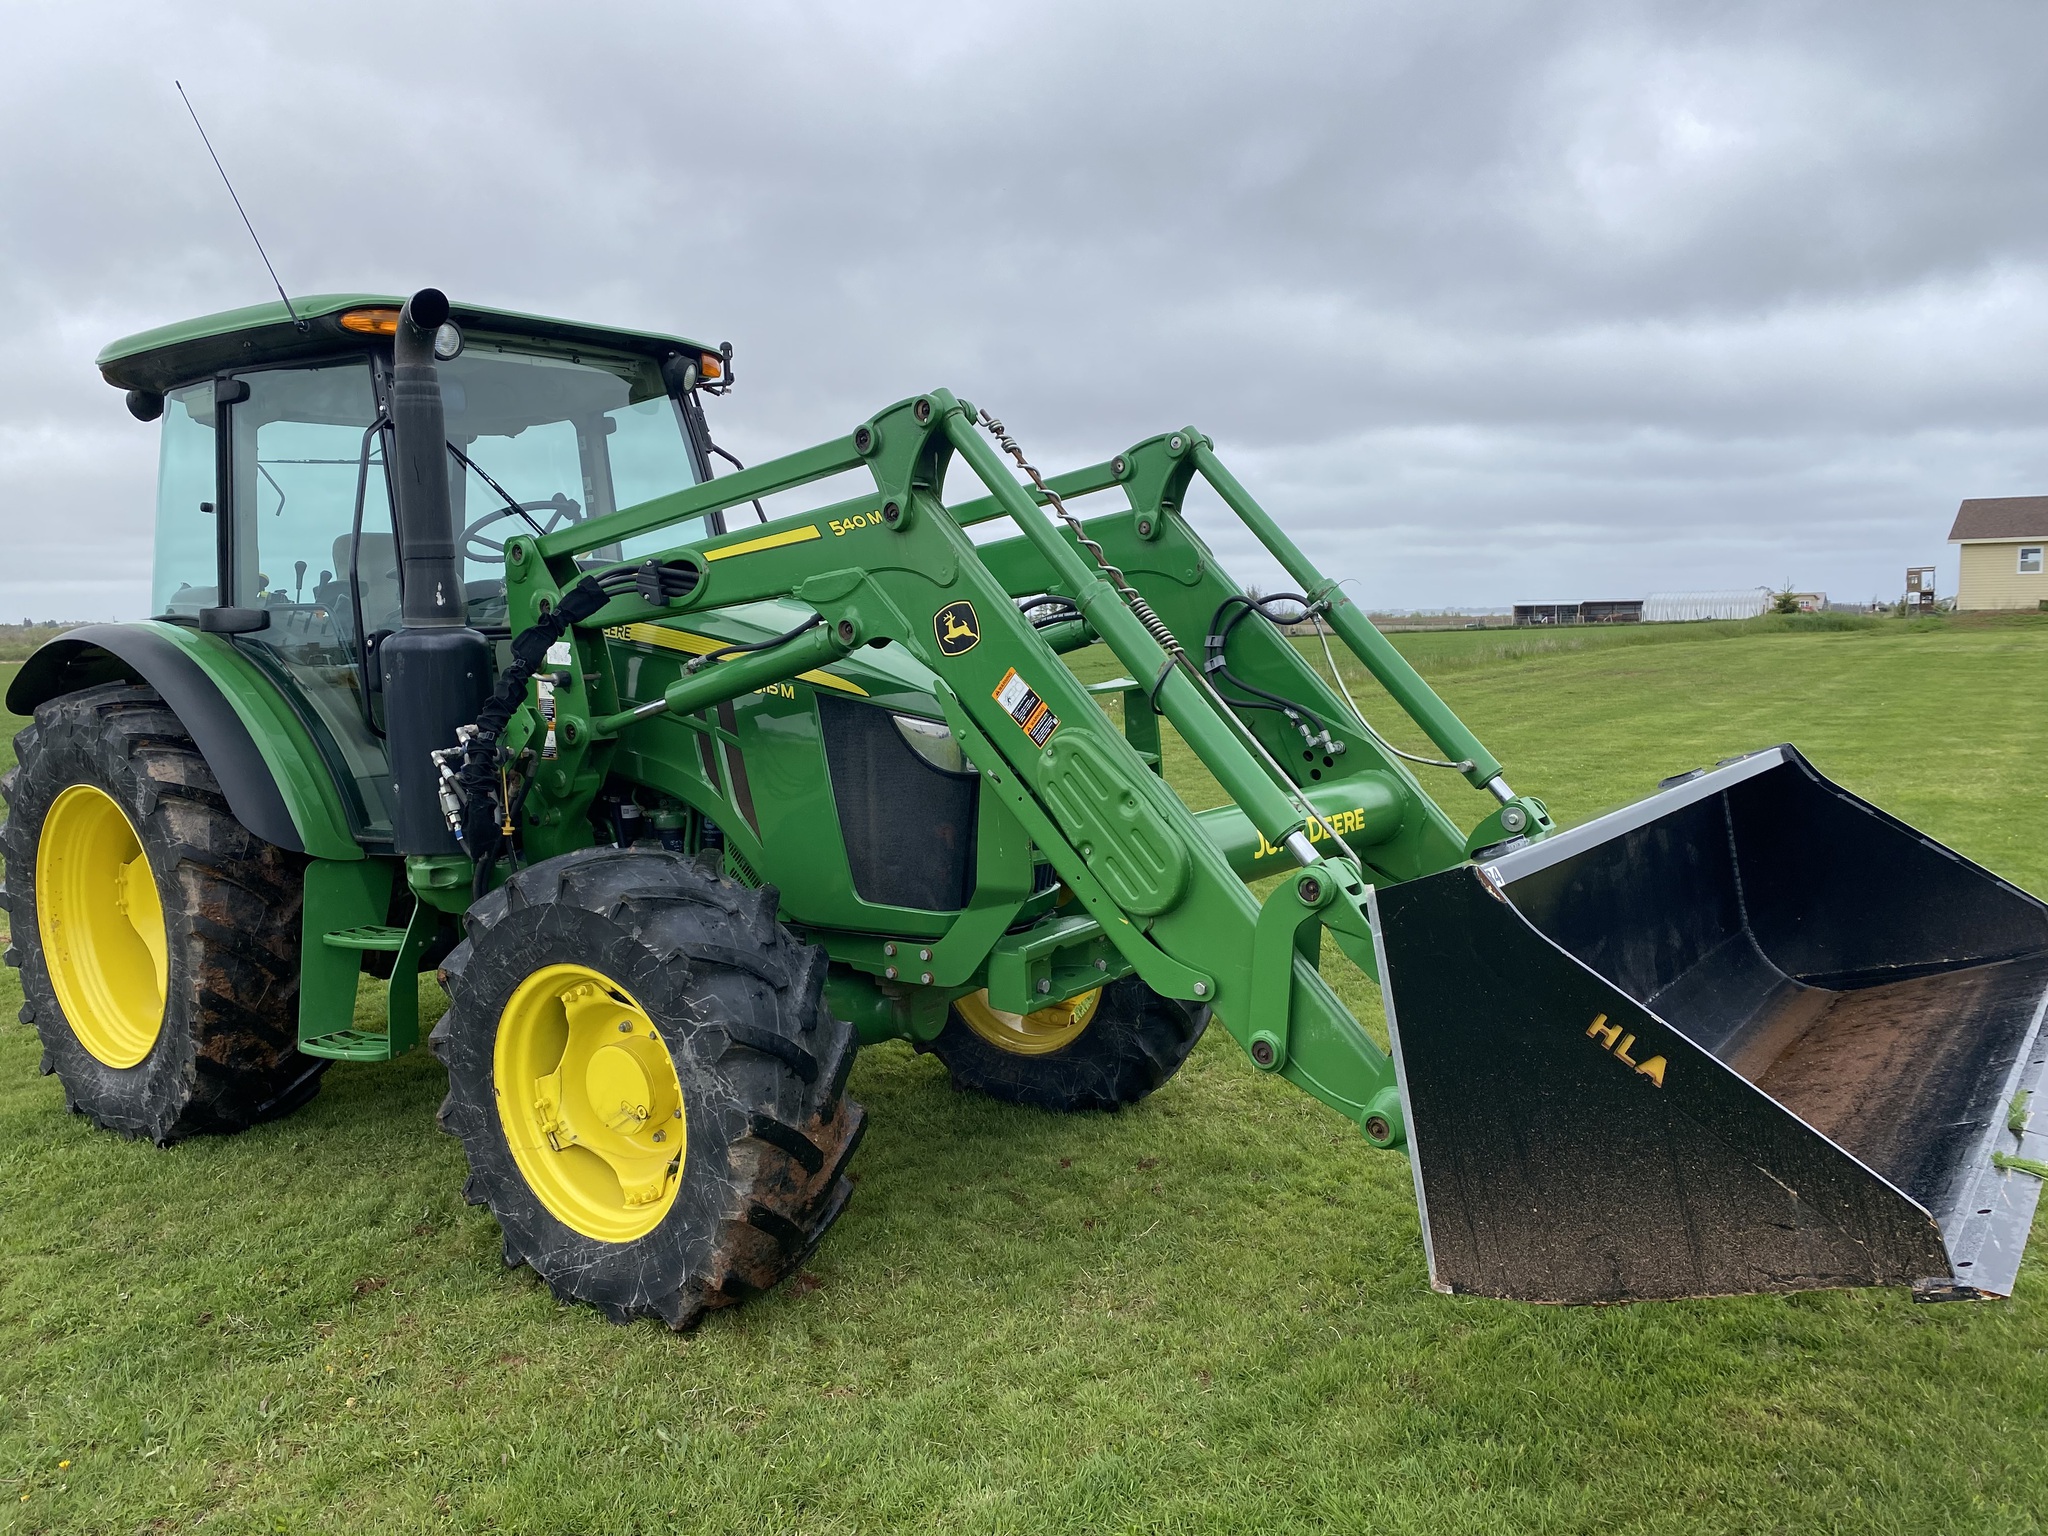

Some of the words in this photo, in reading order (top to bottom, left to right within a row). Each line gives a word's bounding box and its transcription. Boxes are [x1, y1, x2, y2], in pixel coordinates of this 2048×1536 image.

[828, 514, 867, 537] 540
[604, 625, 632, 639] ERE
[1307, 808, 1366, 844] DEERE
[1585, 1012, 1668, 1089] HLA
